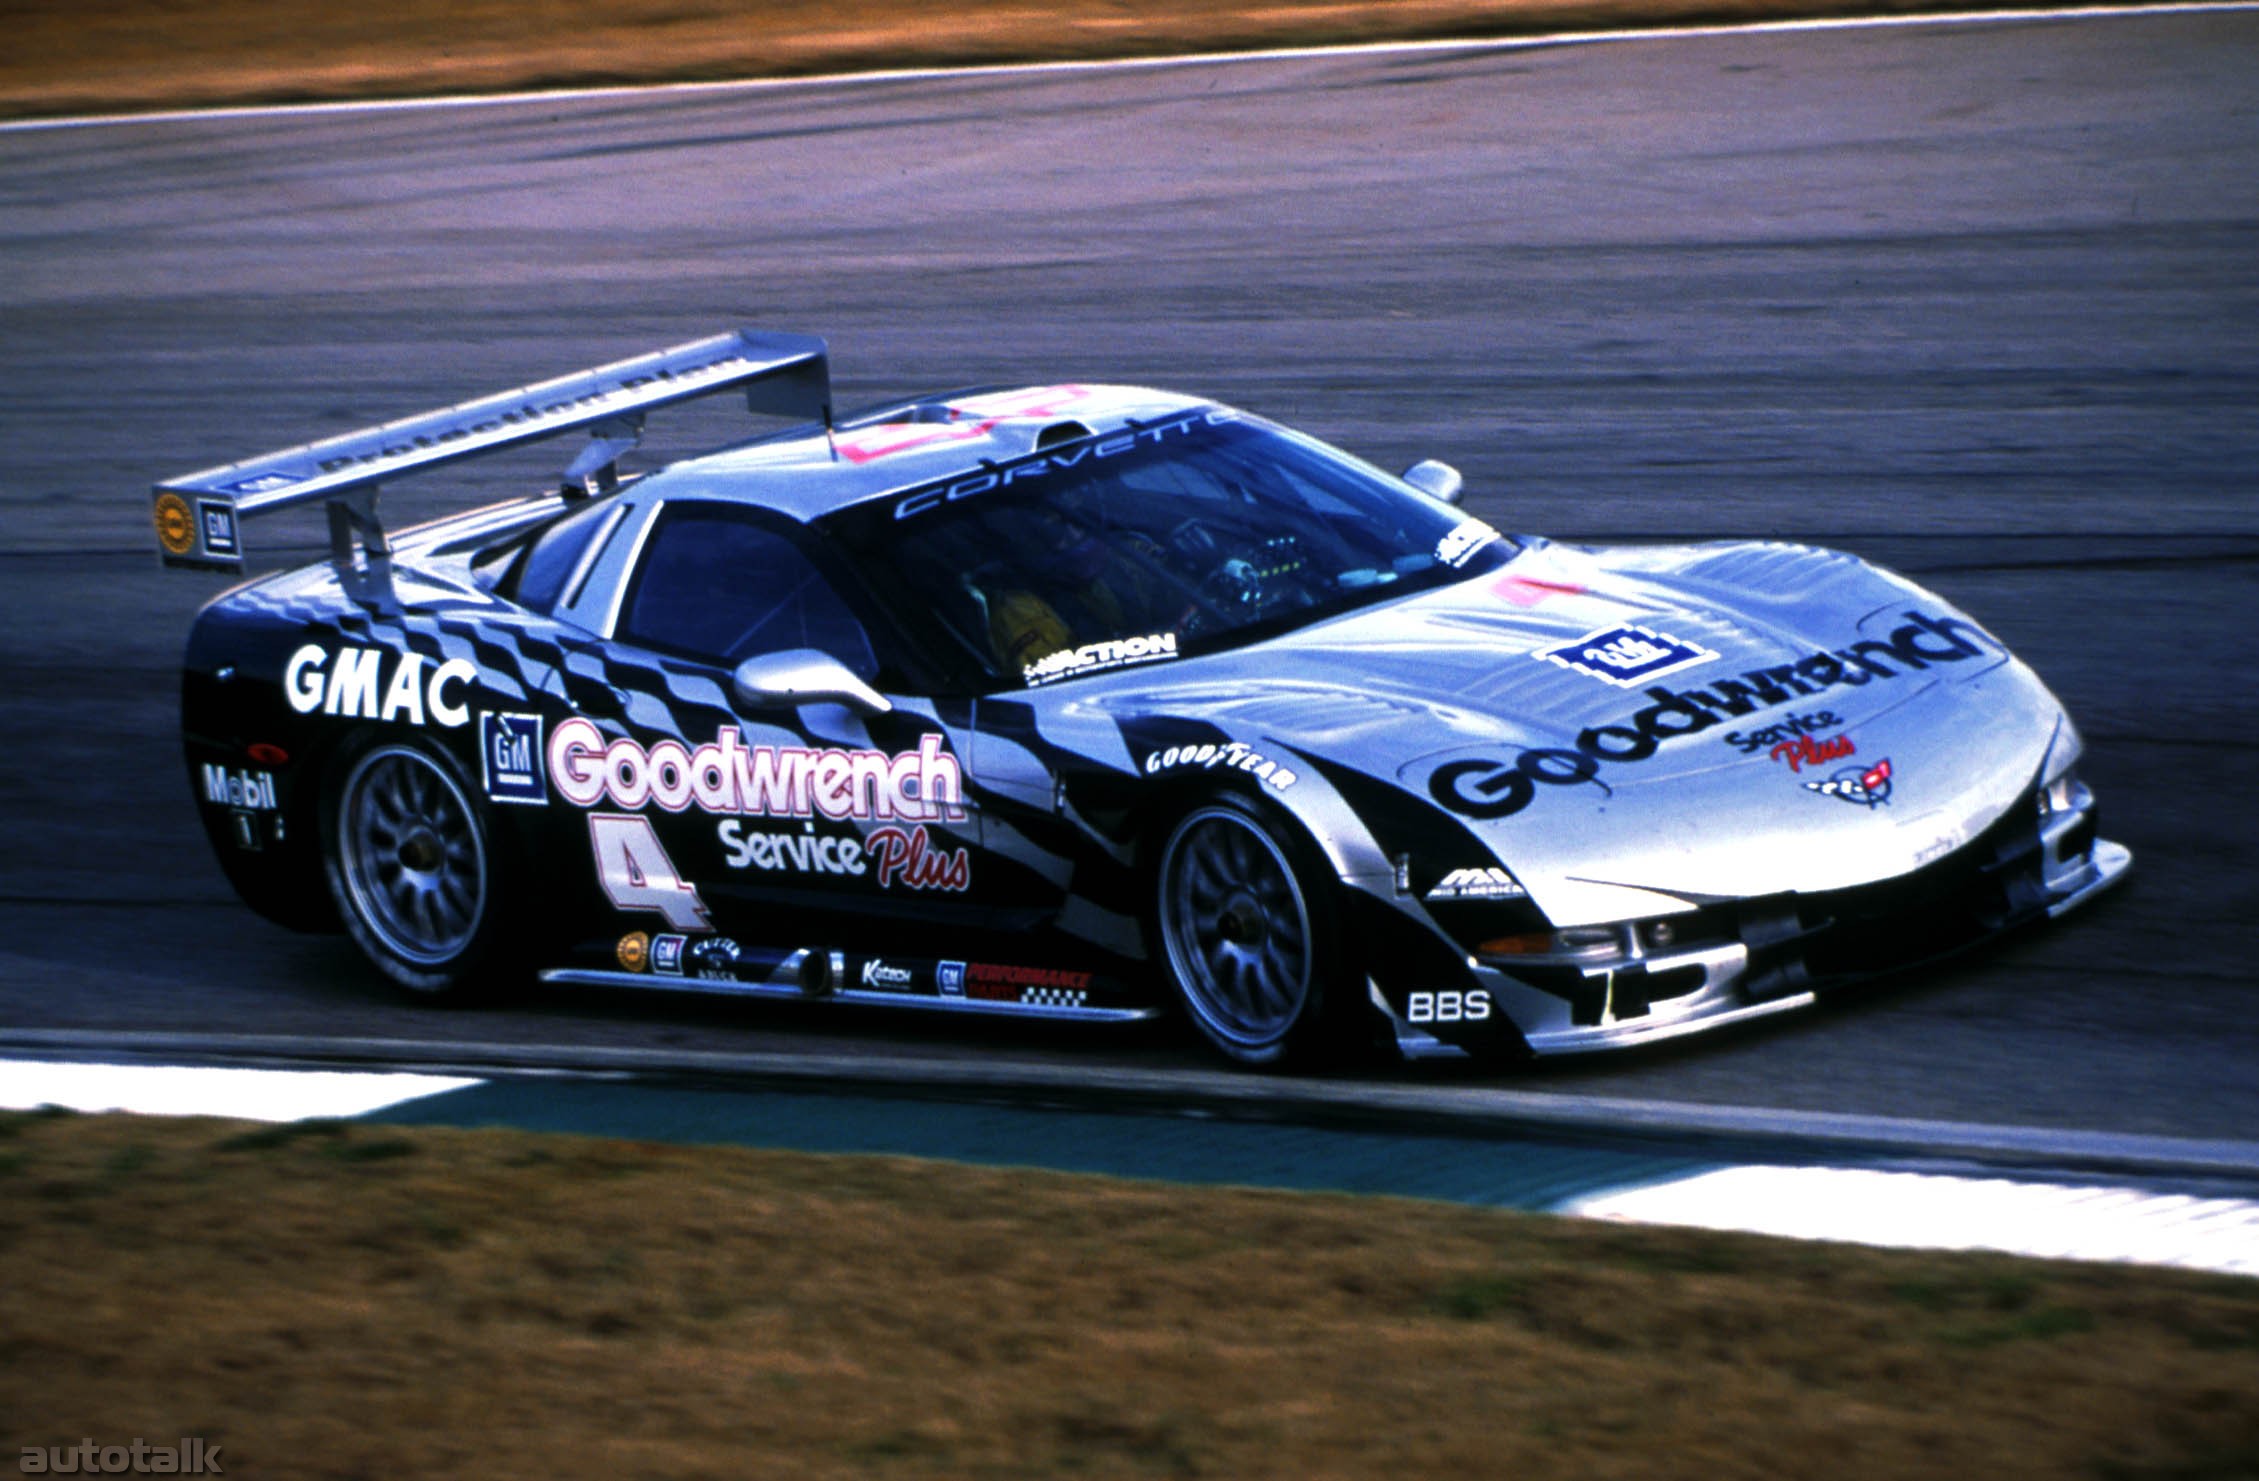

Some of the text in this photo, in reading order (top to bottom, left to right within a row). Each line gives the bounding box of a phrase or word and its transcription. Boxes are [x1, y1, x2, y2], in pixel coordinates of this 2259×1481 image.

[894, 408, 1240, 519] CORVETTE
[206, 511, 231, 537] GM
[286, 644, 477, 727] GMAC
[1429, 610, 1984, 820] Goodwrench
[494, 734, 530, 772] GM
[1725, 708, 1844, 753] Service
[1771, 733, 1856, 772] Plus
[203, 762, 276, 809] Mobil
[549, 717, 967, 822] Goodwrench
[587, 813, 714, 932] 4
[717, 819, 970, 891] Service Plus
[1408, 989, 1490, 1022] BBS
